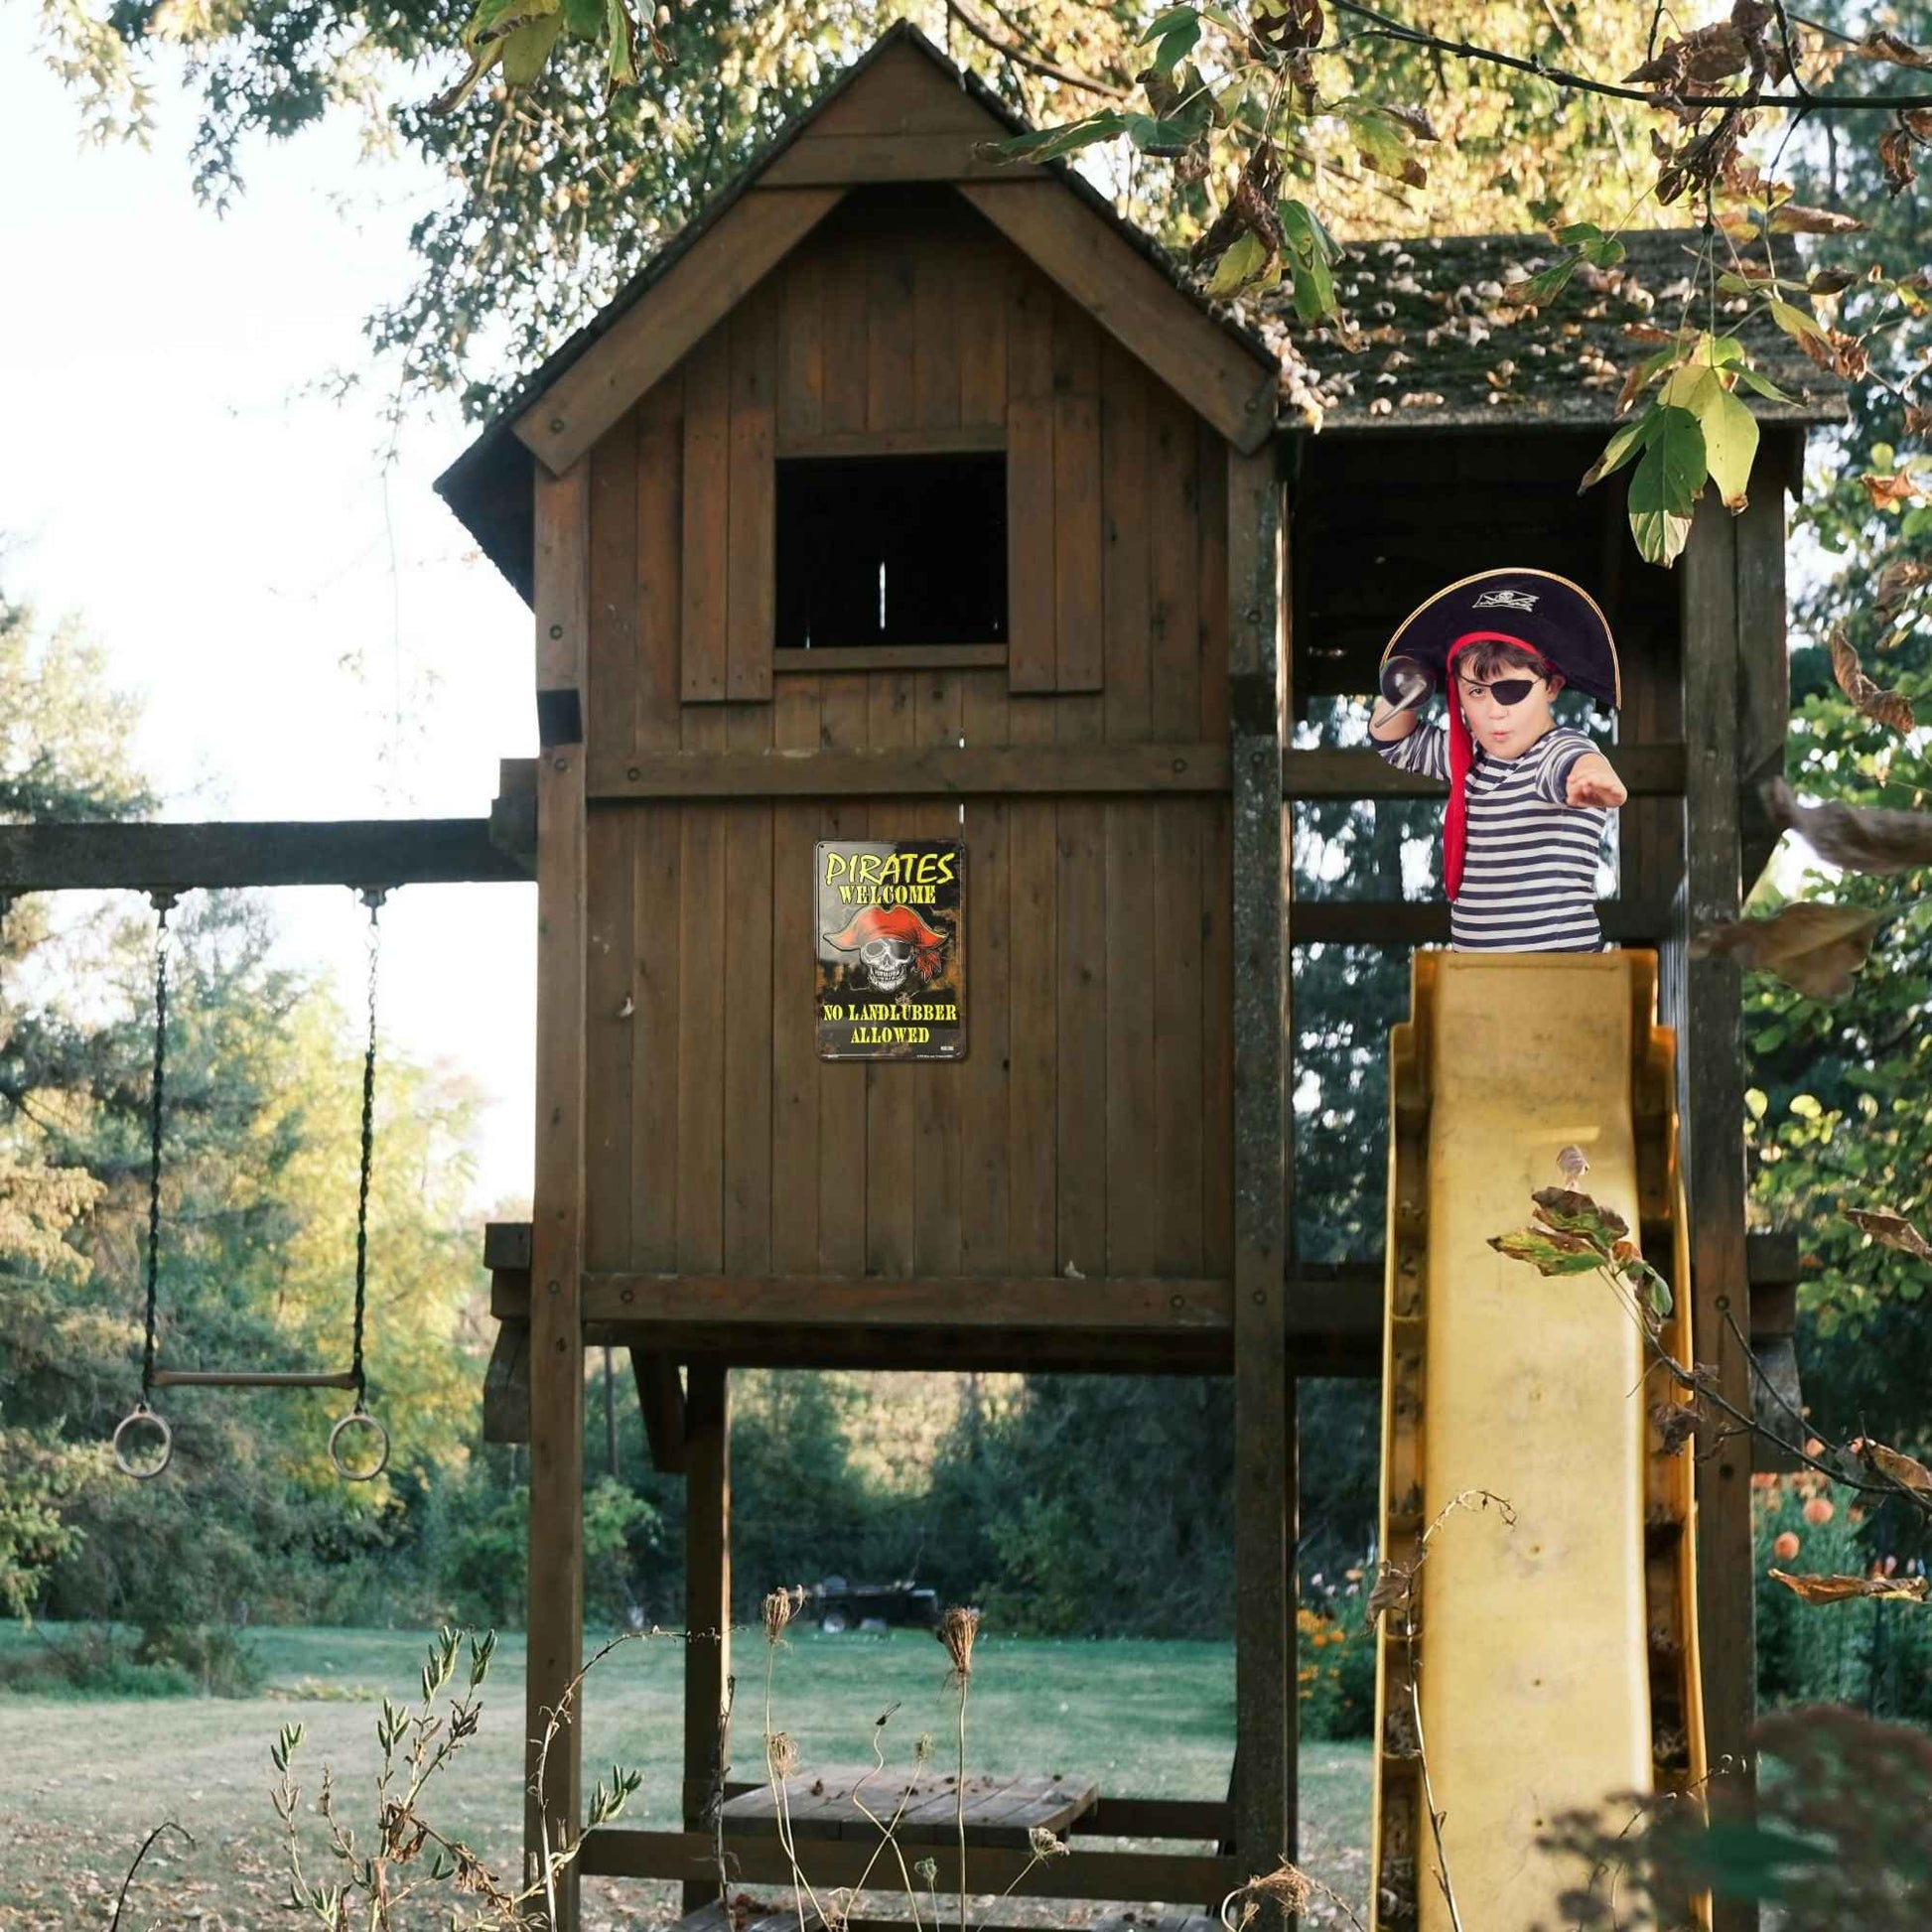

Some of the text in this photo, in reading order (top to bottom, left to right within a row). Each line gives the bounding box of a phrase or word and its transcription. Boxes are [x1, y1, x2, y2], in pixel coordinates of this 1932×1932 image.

[825, 852, 955, 886] PIRATES
[839, 885, 936, 904] WELCOME
[823, 1004, 958, 1022] NO LANDLUBBER
[850, 1027, 930, 1043] ALLOWED
